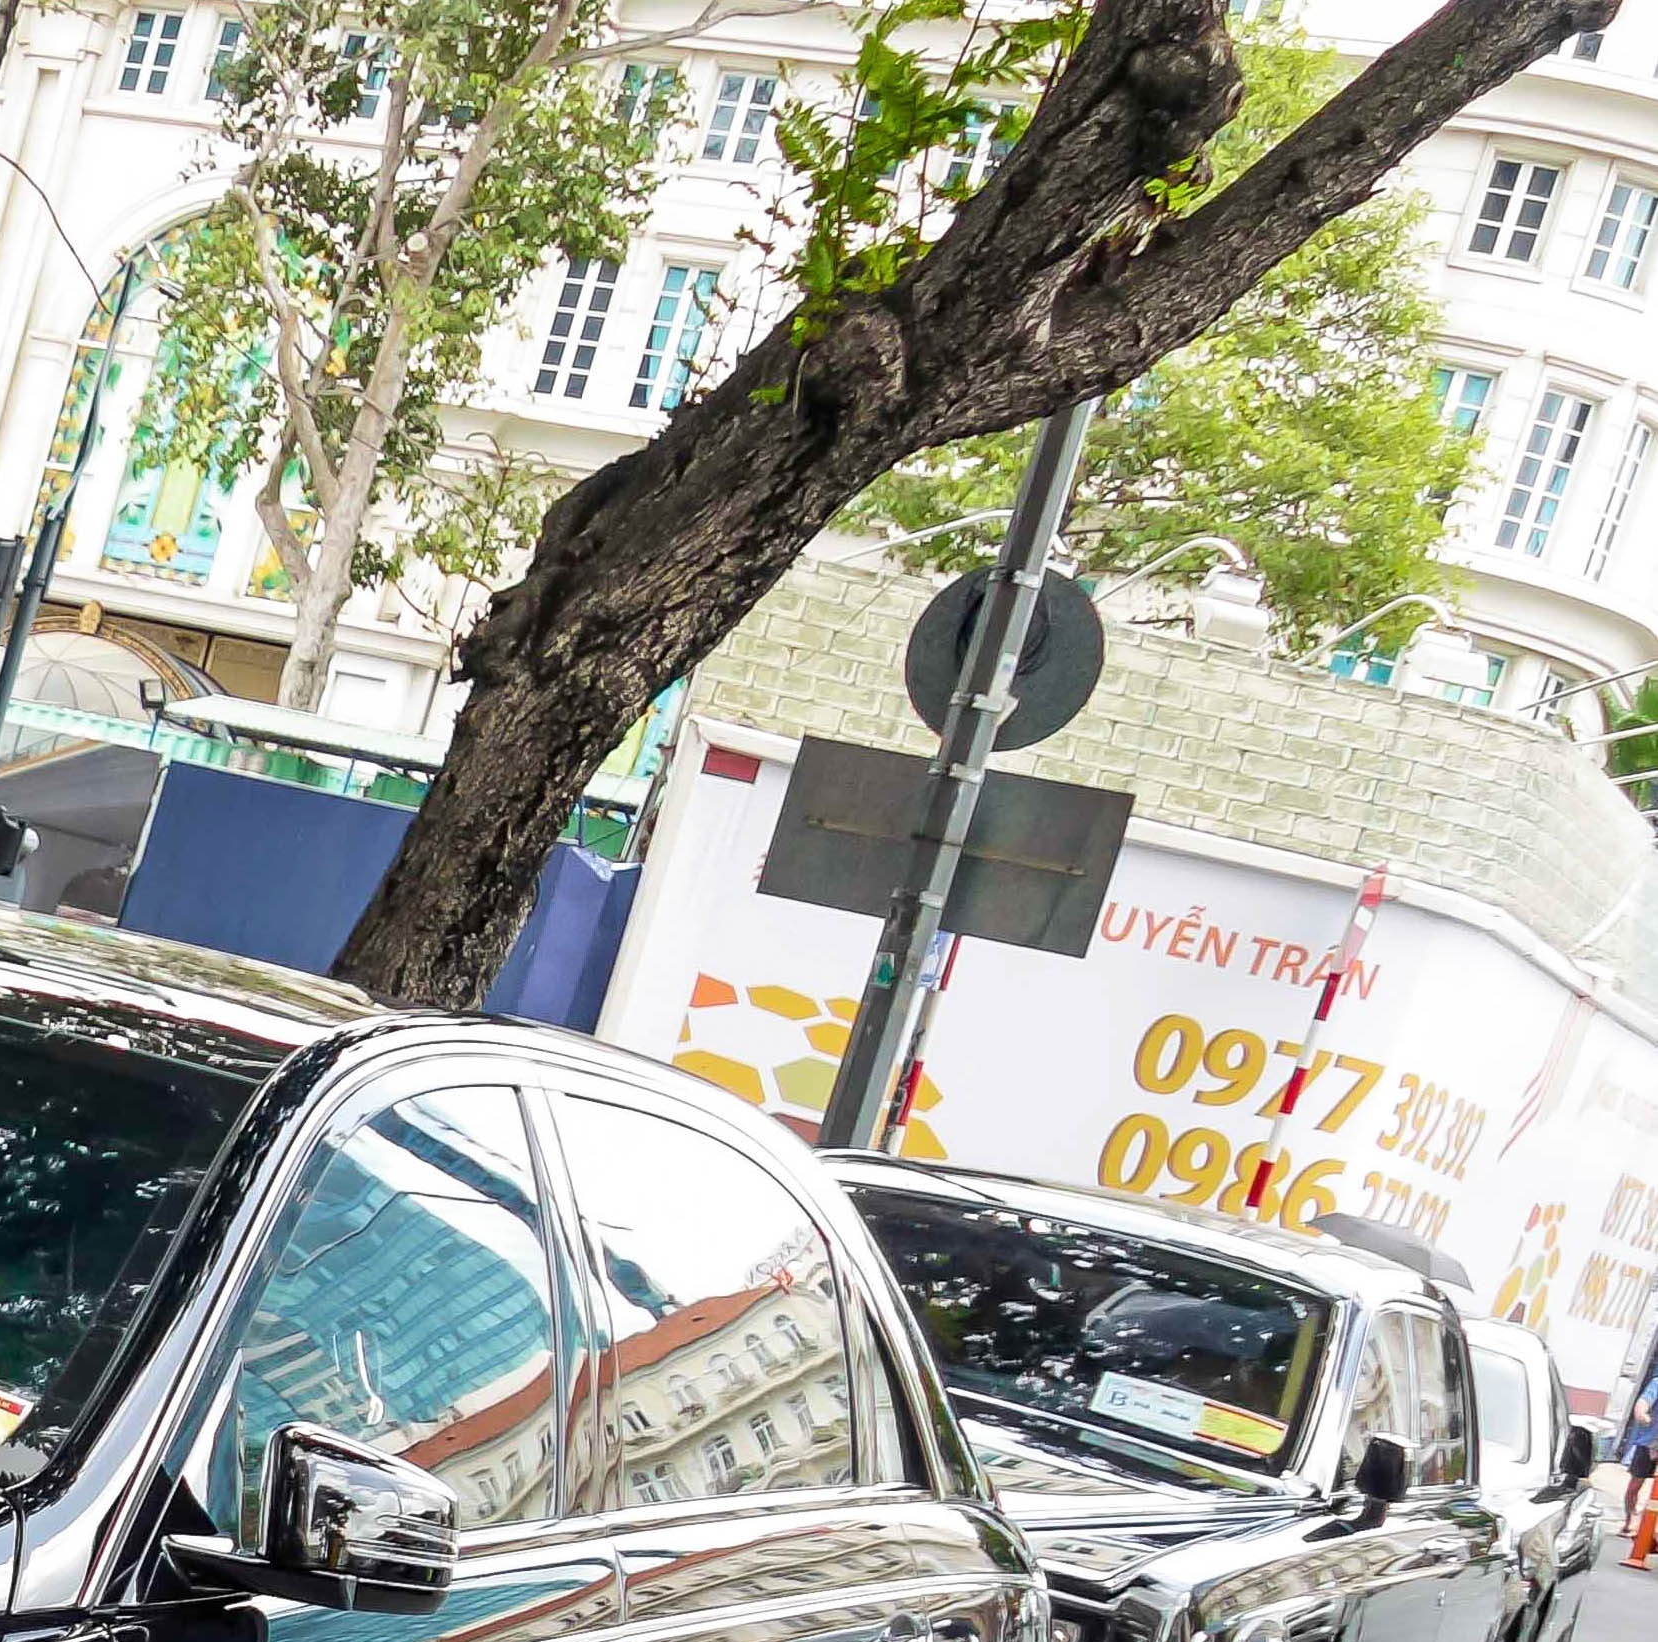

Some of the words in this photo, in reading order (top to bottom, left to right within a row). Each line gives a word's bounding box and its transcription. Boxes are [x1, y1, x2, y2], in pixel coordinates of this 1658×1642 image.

[1099, 901, 1240, 969] UYỄN
[1133, 1013, 1386, 1133] 0977
[1097, 1112, 1348, 1238] 0986
